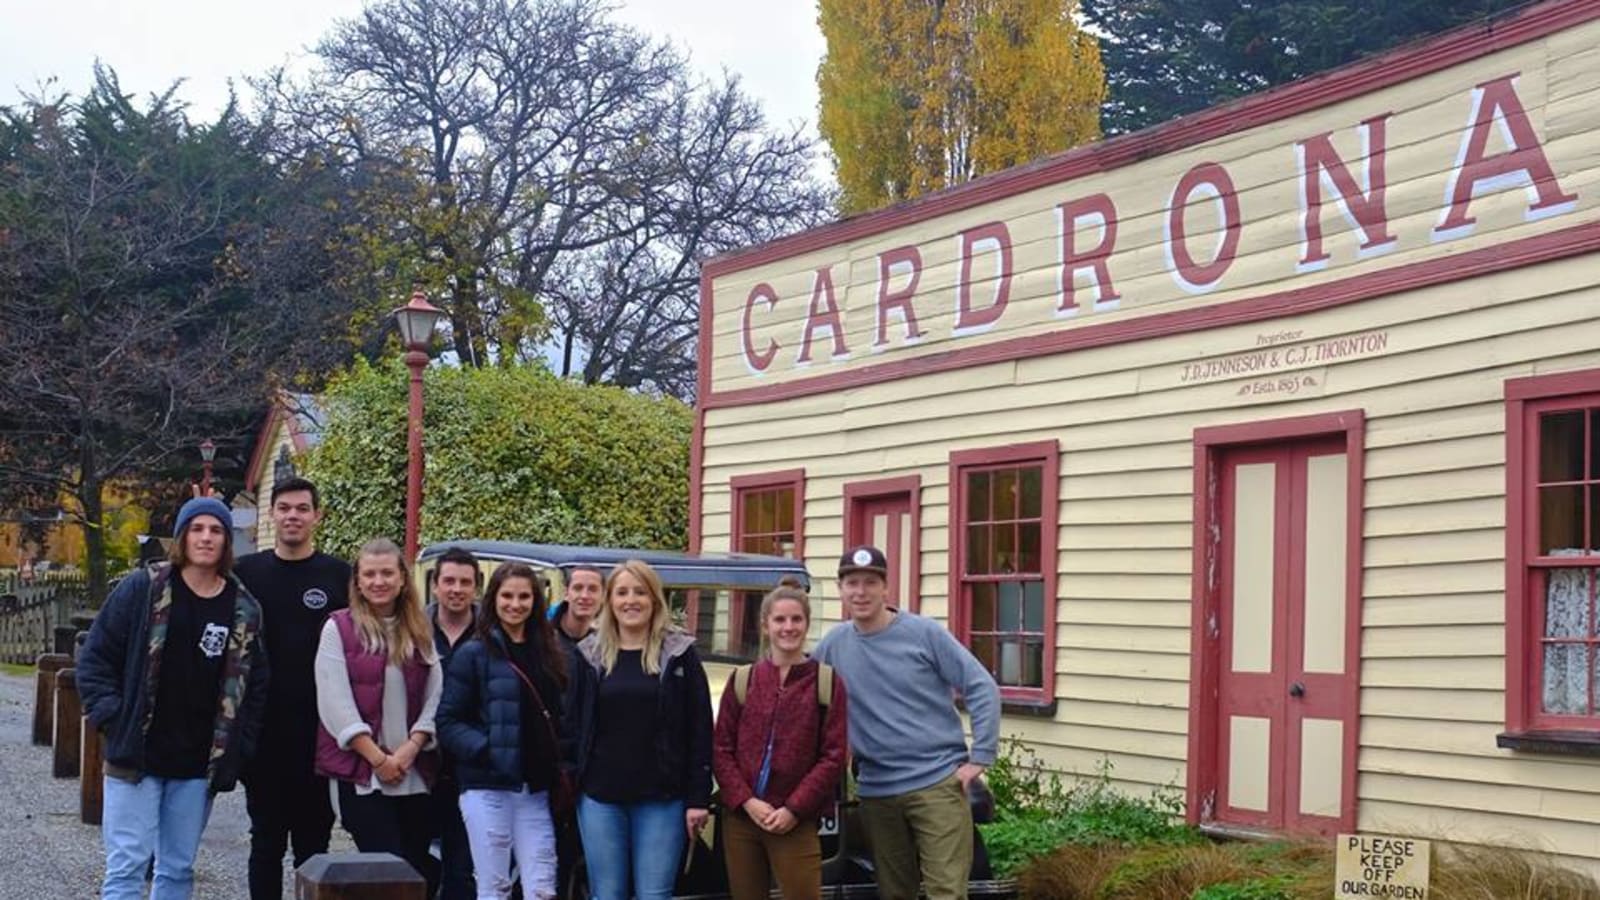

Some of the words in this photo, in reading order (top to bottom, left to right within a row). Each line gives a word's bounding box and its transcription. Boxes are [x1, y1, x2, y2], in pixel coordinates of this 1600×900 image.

[741, 71, 1578, 373] CARDRONA
[1270, 351, 1279, 368] &
[1316, 332, 1388, 361] THORNTON
[1349, 837, 1414, 857] PLEASE
[1360, 854, 1404, 869] KEEP
[1364, 868, 1395, 882] OFF
[1342, 880, 1368, 896] OUR
[1370, 883, 1424, 899] GARDEN
